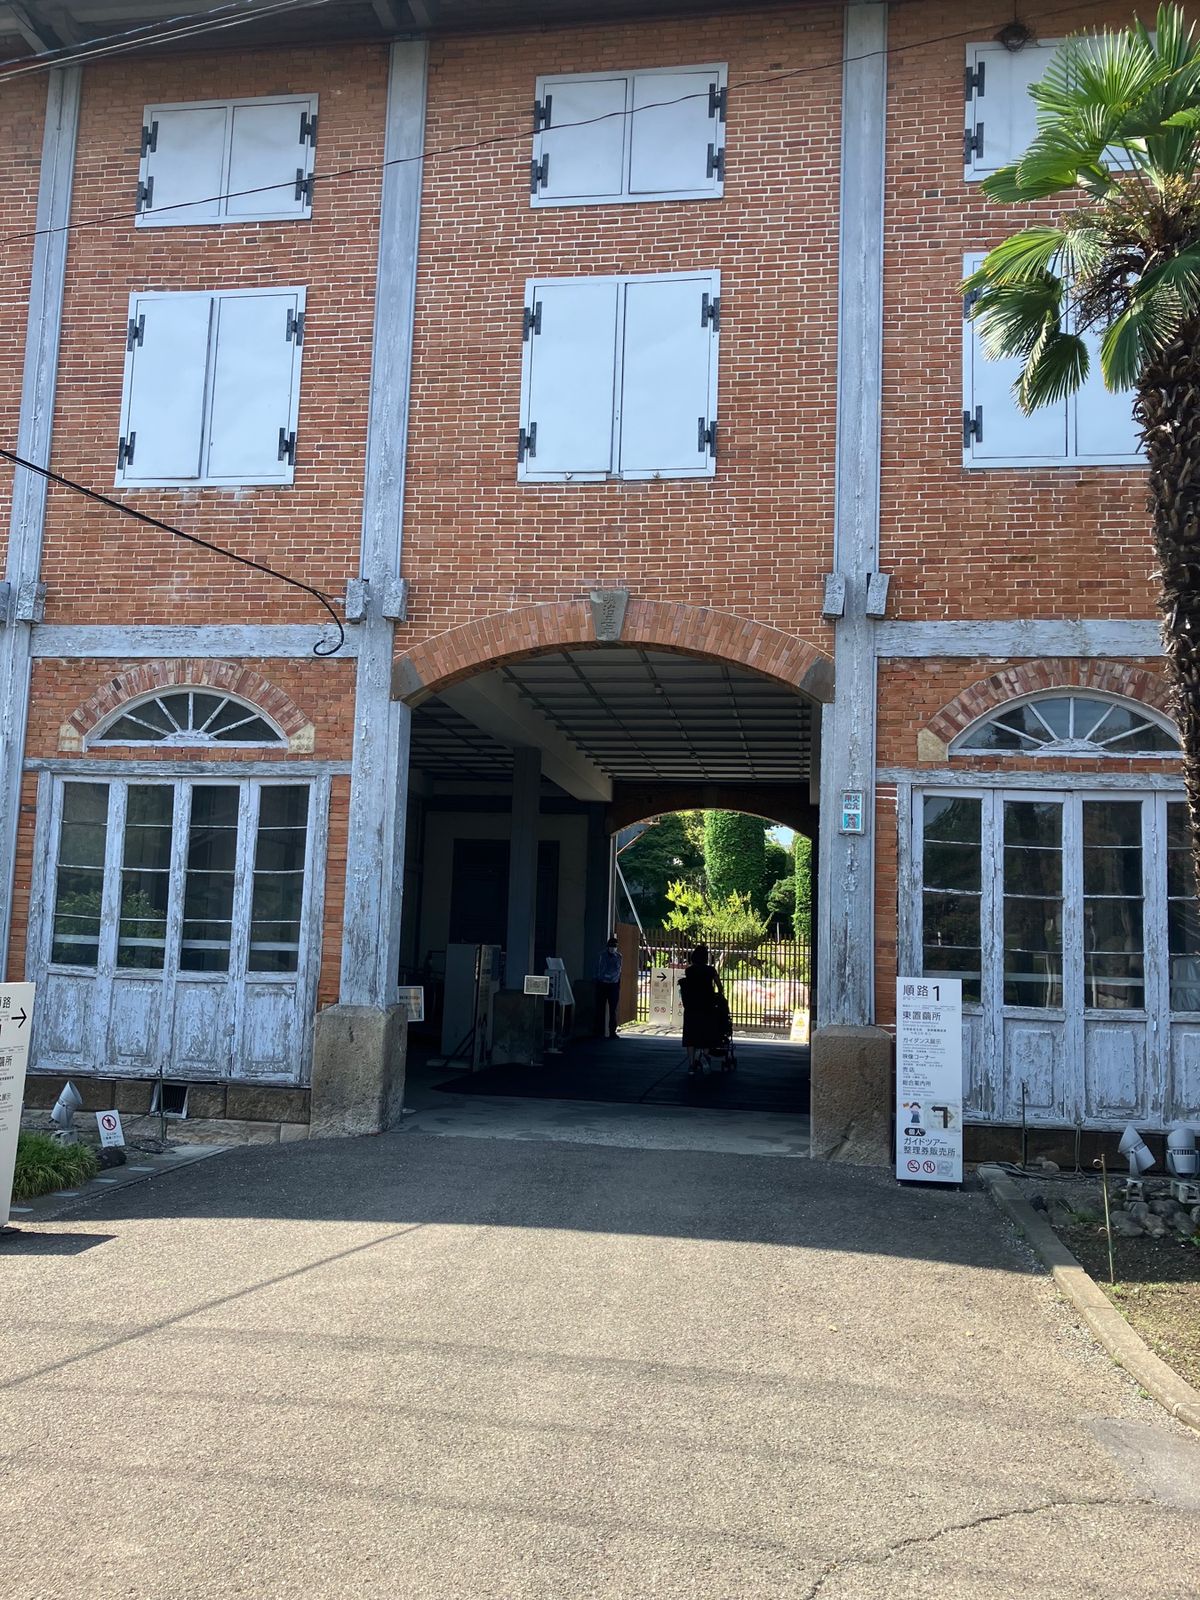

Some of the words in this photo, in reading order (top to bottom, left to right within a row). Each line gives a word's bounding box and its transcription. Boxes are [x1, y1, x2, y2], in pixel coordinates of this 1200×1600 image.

[903, 985, 928, 997] 順路
[932, 985, 940, 1001] 1
[904, 1137, 948, 1146] ガイドツアー
[904, 1146, 956, 1158] 整理券販売所
